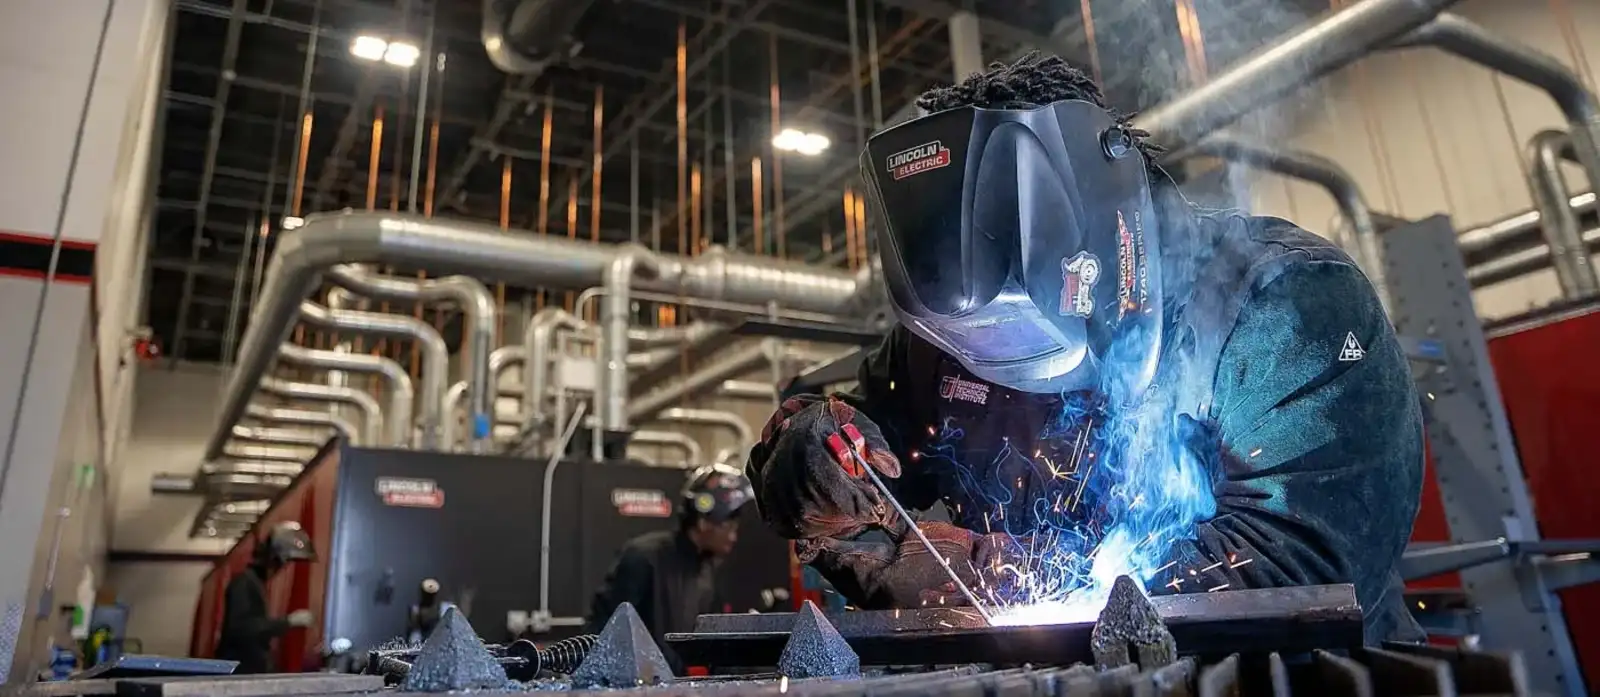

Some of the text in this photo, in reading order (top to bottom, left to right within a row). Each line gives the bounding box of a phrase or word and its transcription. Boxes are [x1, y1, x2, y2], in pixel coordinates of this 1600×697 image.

[890, 144, 937, 168] LINCOLN
[900, 156, 943, 175] ELECTRIC
[957, 380, 990, 393] UNIVERSAL
[954, 392, 986, 405] INSTITUTE
